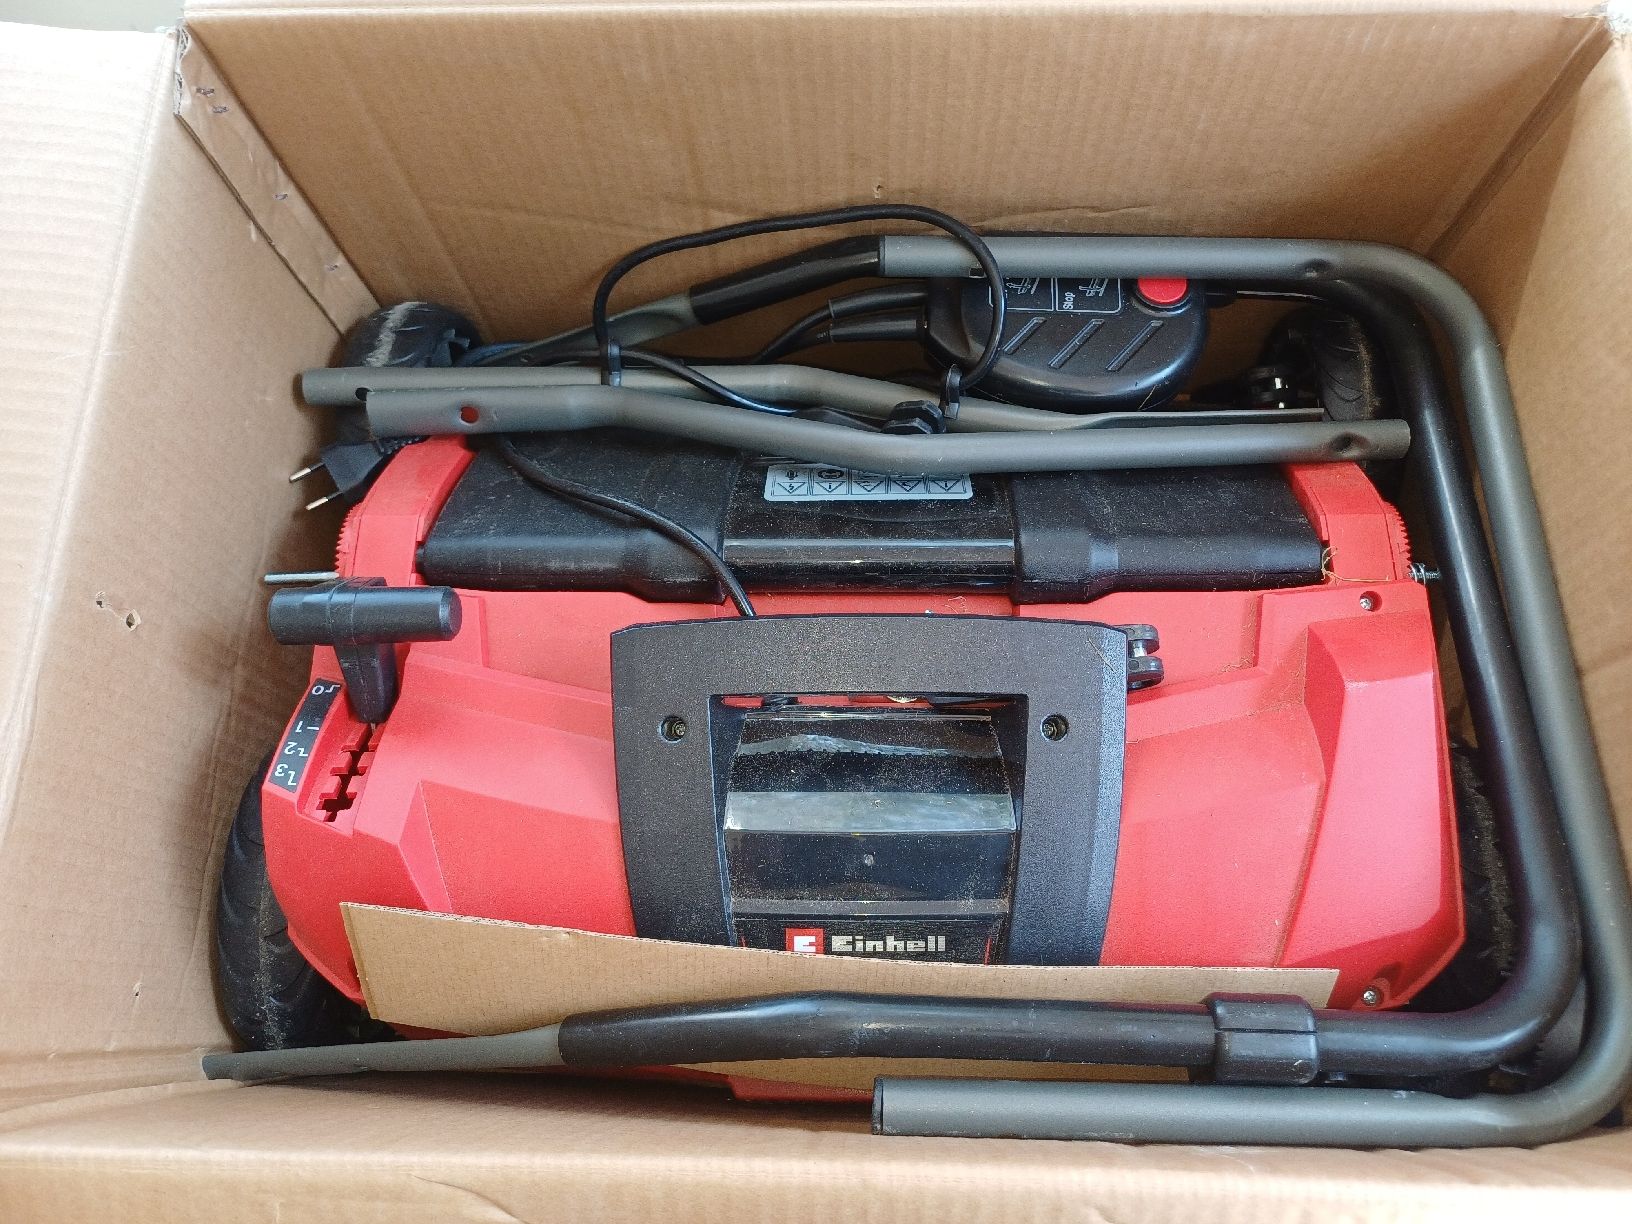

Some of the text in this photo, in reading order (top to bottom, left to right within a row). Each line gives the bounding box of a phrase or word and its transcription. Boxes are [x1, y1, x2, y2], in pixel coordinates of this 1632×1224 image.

[1062, 292, 1076, 310] Stop
[312, 685, 324, 695] 0
[284, 742, 298, 755] 2
[274, 764, 288, 776] 3
[831, 935, 946, 952] Einhell
